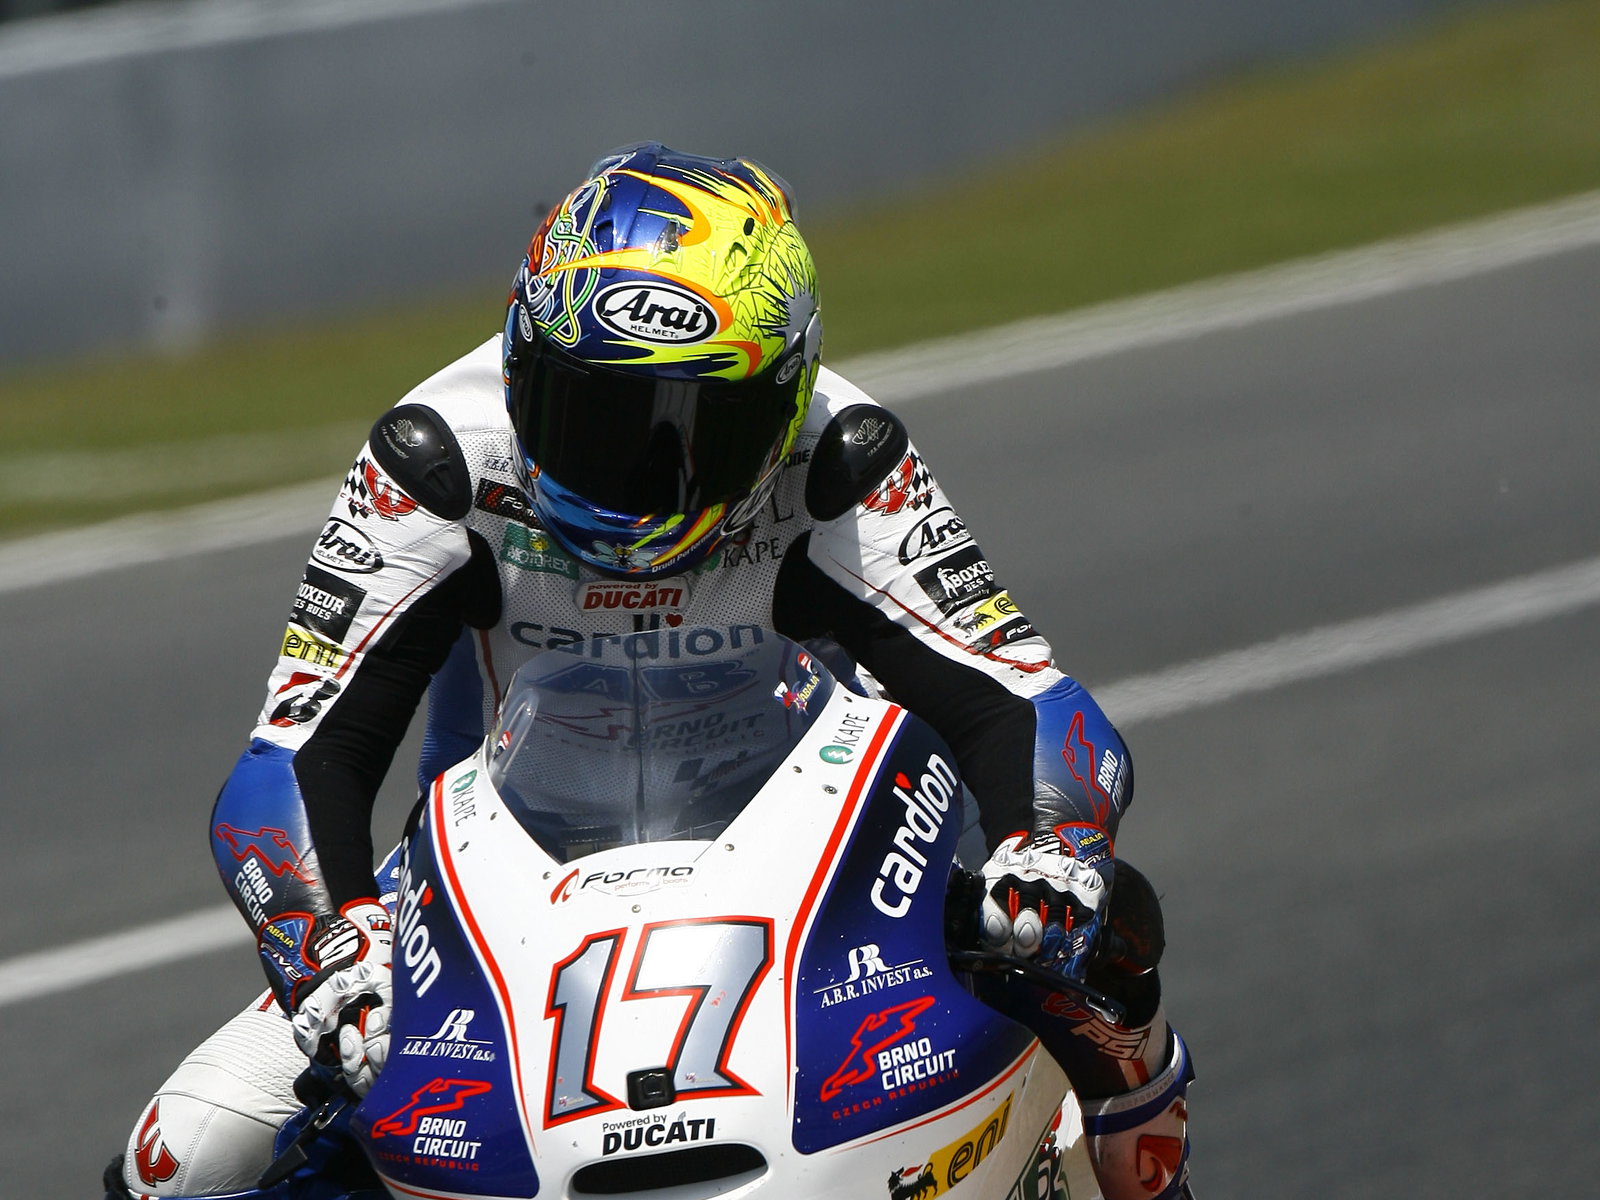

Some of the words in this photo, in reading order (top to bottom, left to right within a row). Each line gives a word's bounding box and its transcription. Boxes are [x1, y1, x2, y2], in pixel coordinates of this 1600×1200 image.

[602, 290, 704, 330] Arai
[630, 323, 676, 338] HELMET
[318, 521, 373, 565] Arai
[919, 516, 967, 549] Ara
[722, 538, 783, 568] KAPE
[587, 582, 641, 592] powered
[644, 583, 659, 592] by
[951, 560, 994, 588] BOXE
[963, 578, 984, 594] DES
[298, 582, 346, 616] OXEUR
[305, 603, 332, 621] RUES
[583, 588, 683, 610] DUCATI
[510, 613, 764, 662] cardion
[832, 713, 871, 747] KAPE
[1097, 749, 1119, 794] BRNO
[454, 788, 477, 828] KAPE
[870, 753, 959, 918] cardion
[242, 857, 274, 905] BRNO
[580, 867, 694, 889] Forma
[820, 986, 860, 1009] A.B.R.
[860, 966, 912, 997] INVEST
[913, 966, 934, 982] a.s.
[543, 915, 775, 1130] 17
[430, 1041, 476, 1061] INVEST
[877, 1037, 932, 1072] BRNO
[882, 1049, 956, 1091] CIRCUIT
[832, 1095, 882, 1120] CZECH
[888, 1070, 961, 1103] REPUBLIC
[418, 1116, 467, 1138] BRNO
[602, 1115, 651, 1132] Powered
[652, 1113, 668, 1128] by
[602, 1118, 715, 1156] DUCATI
[413, 1136, 482, 1160] CIRCUIT
[947, 1092, 1013, 1189] eni
[414, 1156, 479, 1172] REPUBLIC
